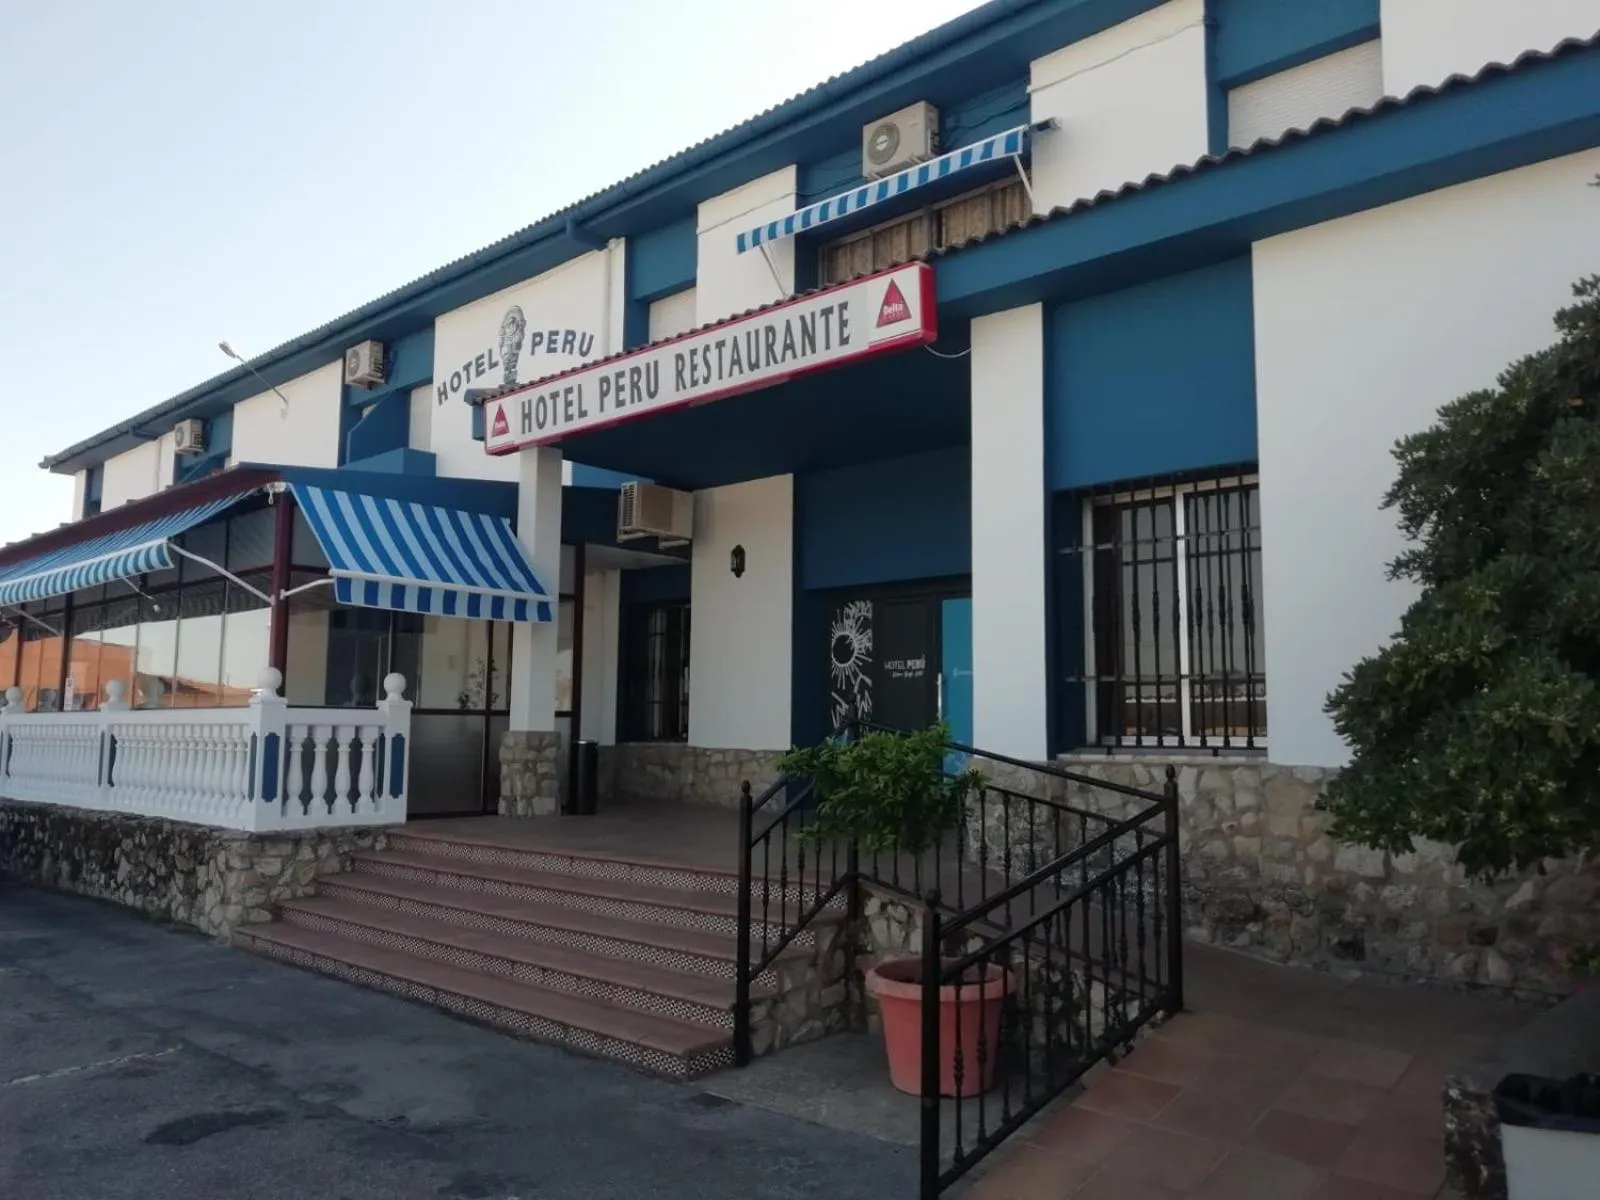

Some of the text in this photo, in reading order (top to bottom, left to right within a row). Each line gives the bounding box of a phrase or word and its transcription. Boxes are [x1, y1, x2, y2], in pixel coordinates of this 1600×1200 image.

[437, 329, 594, 405] HOTEL PERU
[521, 301, 851, 434] HOTEL PERU RESTAURANTE
